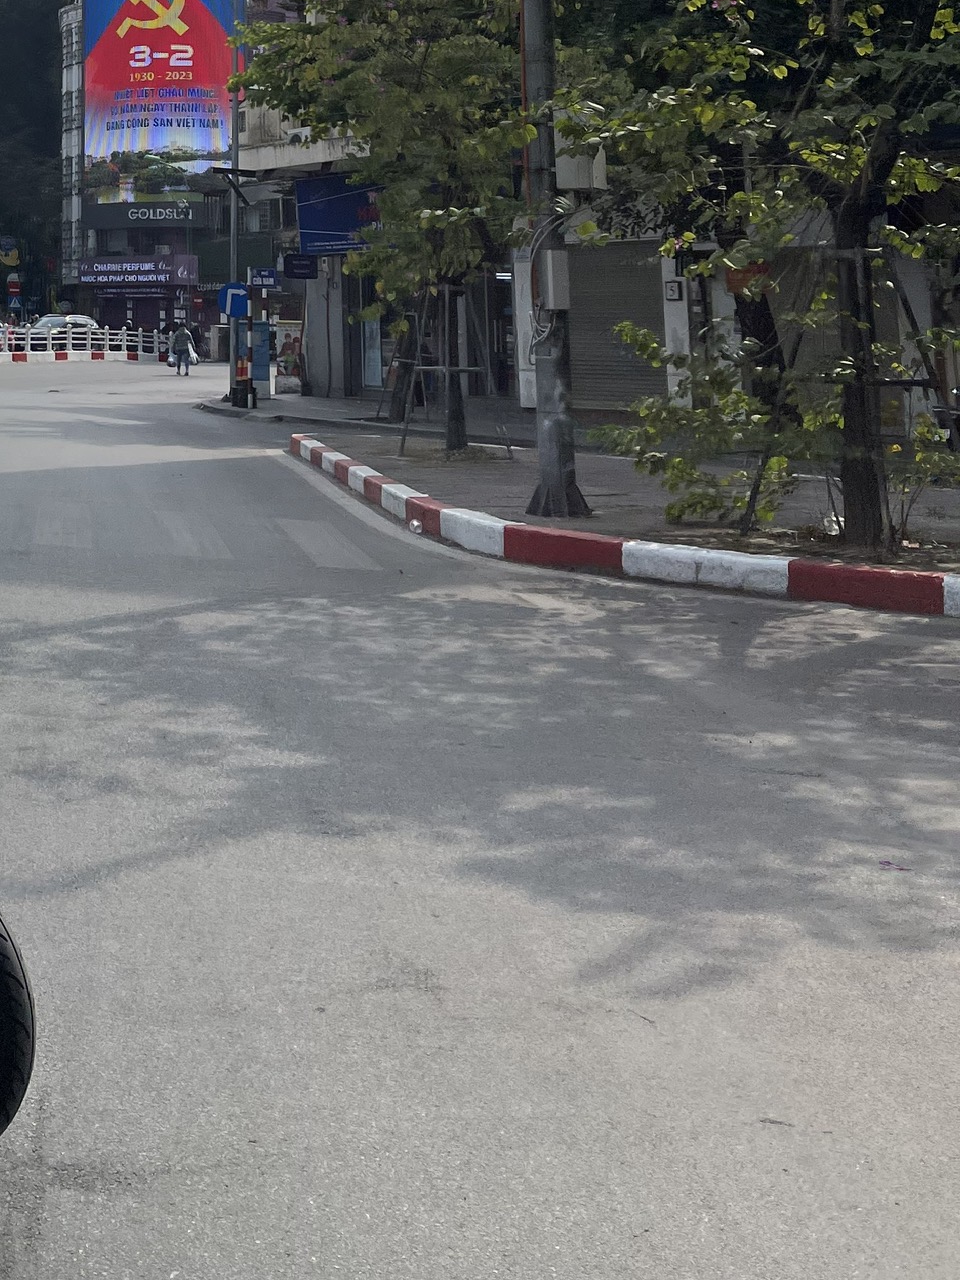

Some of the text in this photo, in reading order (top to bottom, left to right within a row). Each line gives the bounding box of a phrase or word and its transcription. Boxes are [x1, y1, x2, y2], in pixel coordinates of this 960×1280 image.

[129, 44, 194, 68] 3-2
[130, 72, 155, 82] 1930
[166, 72, 193, 81] 2023
[176, 116, 197, 130] VIỆT
[123, 263, 156, 272] PERFUME
[670, 286, 675, 297] 5
